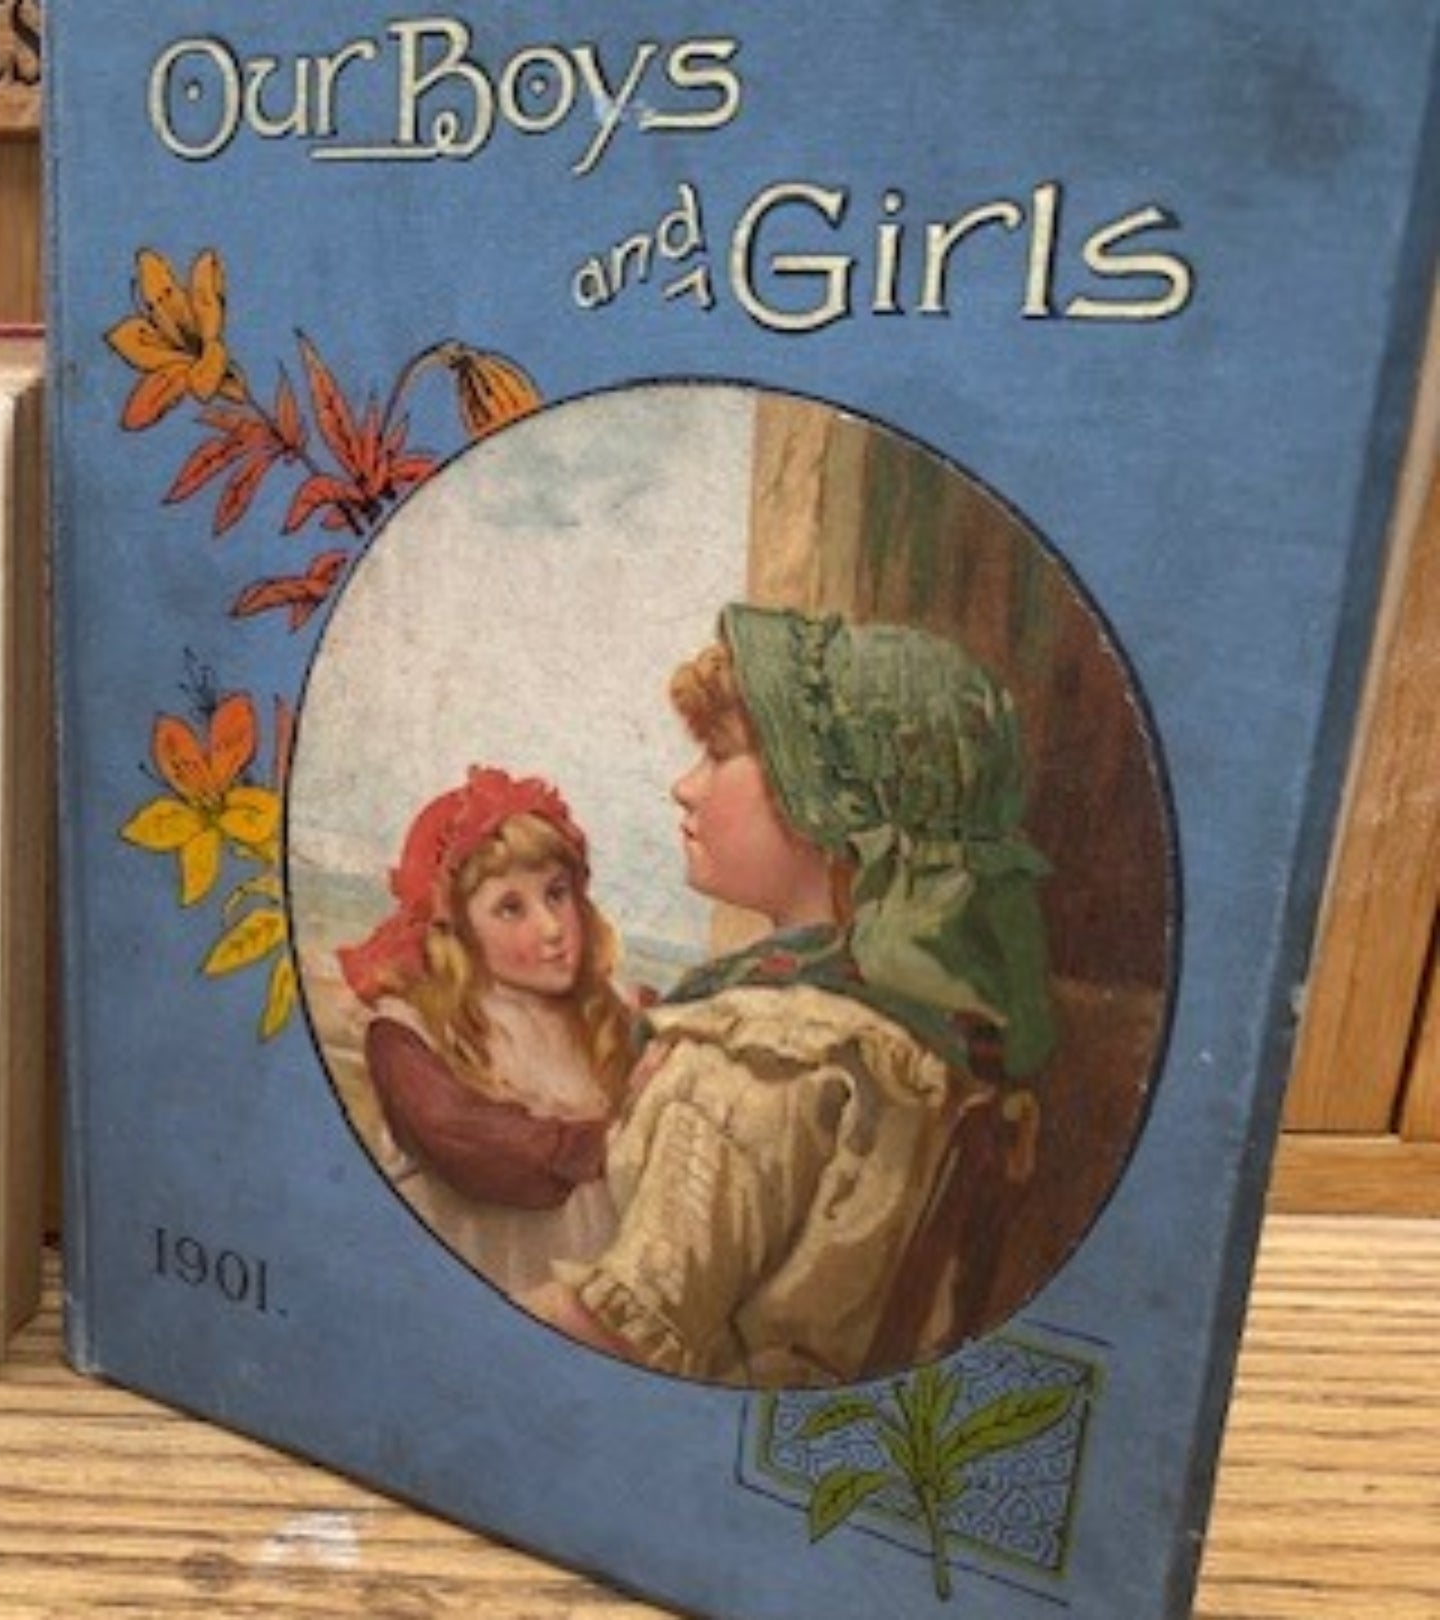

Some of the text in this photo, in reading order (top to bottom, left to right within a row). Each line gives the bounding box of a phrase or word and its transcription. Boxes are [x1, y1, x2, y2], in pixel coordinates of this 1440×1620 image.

[147, 15, 743, 176] Our Boys
[571, 180, 1197, 333] and Girls
